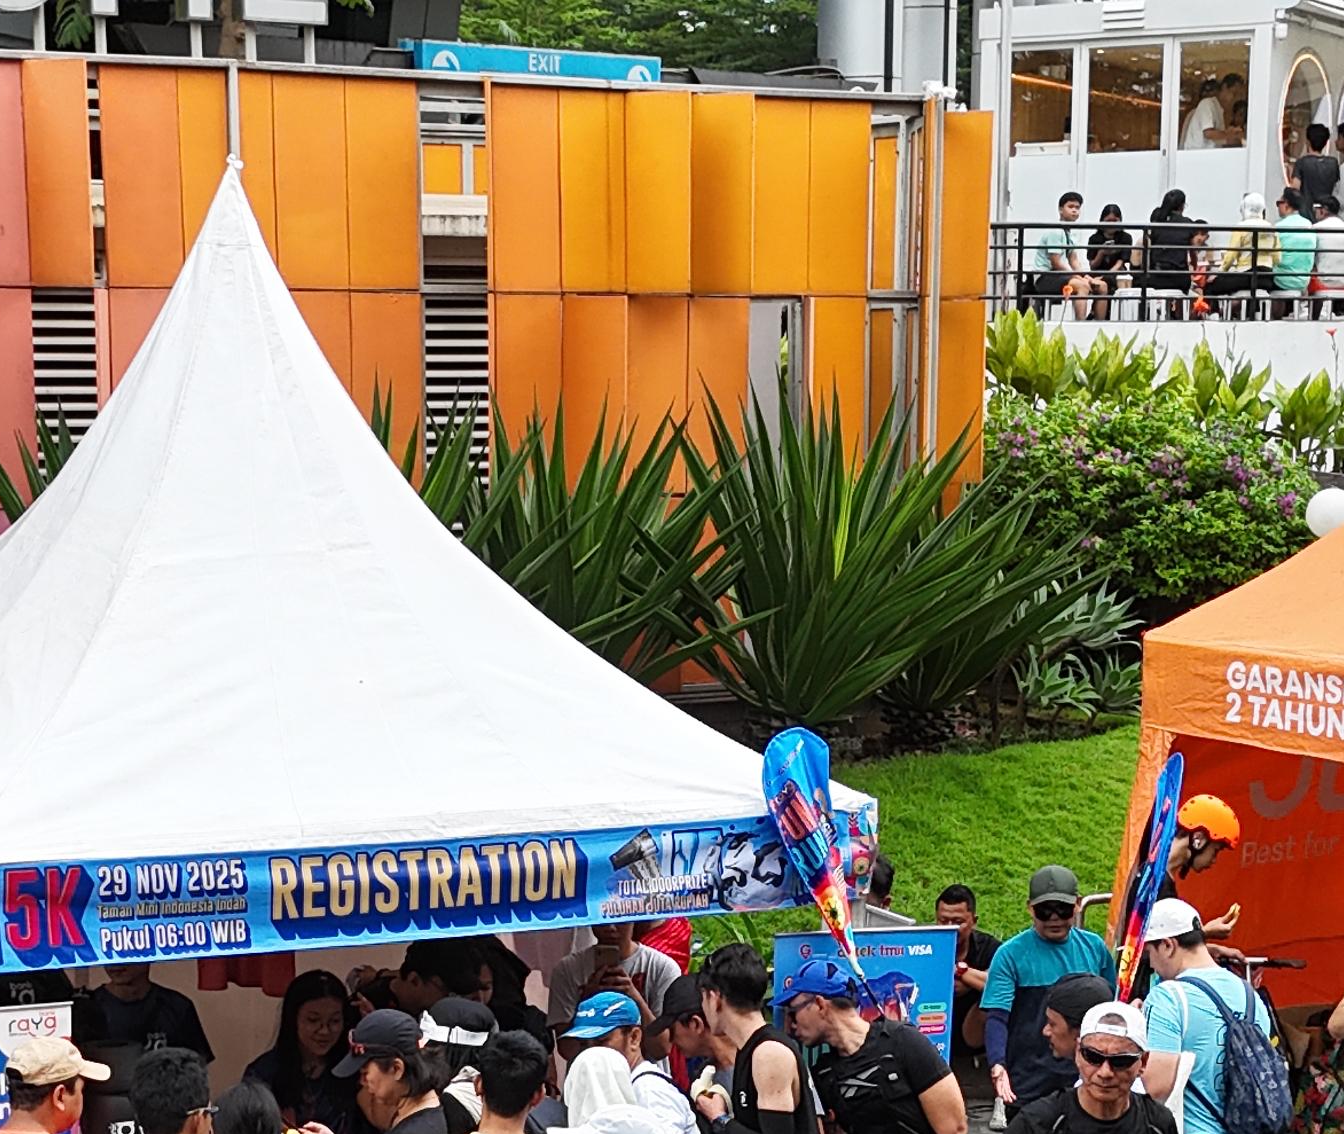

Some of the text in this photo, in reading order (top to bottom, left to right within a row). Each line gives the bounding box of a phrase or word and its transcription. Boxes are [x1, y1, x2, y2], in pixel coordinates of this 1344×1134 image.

[528, 53, 561, 74] EXIT
[1225, 692, 1242, 723] 2
[1241, 836, 1296, 867] Best
[97, 859, 245, 896] 29 NOV 2025
[270, 838, 578, 922] REGISTRATION
[617, 873, 708, 898] TOTAL DOORPRIZE
[6, 867, 86, 950] 5K
[97, 897, 246, 919] Taman Mini Indonesia Indah
[600, 897, 645, 919] PULUHAN
[674, 891, 709, 913] RUPIAH
[100, 919, 247, 952] Pukul 06:00 WIB
[908, 944, 932, 956] VISA
